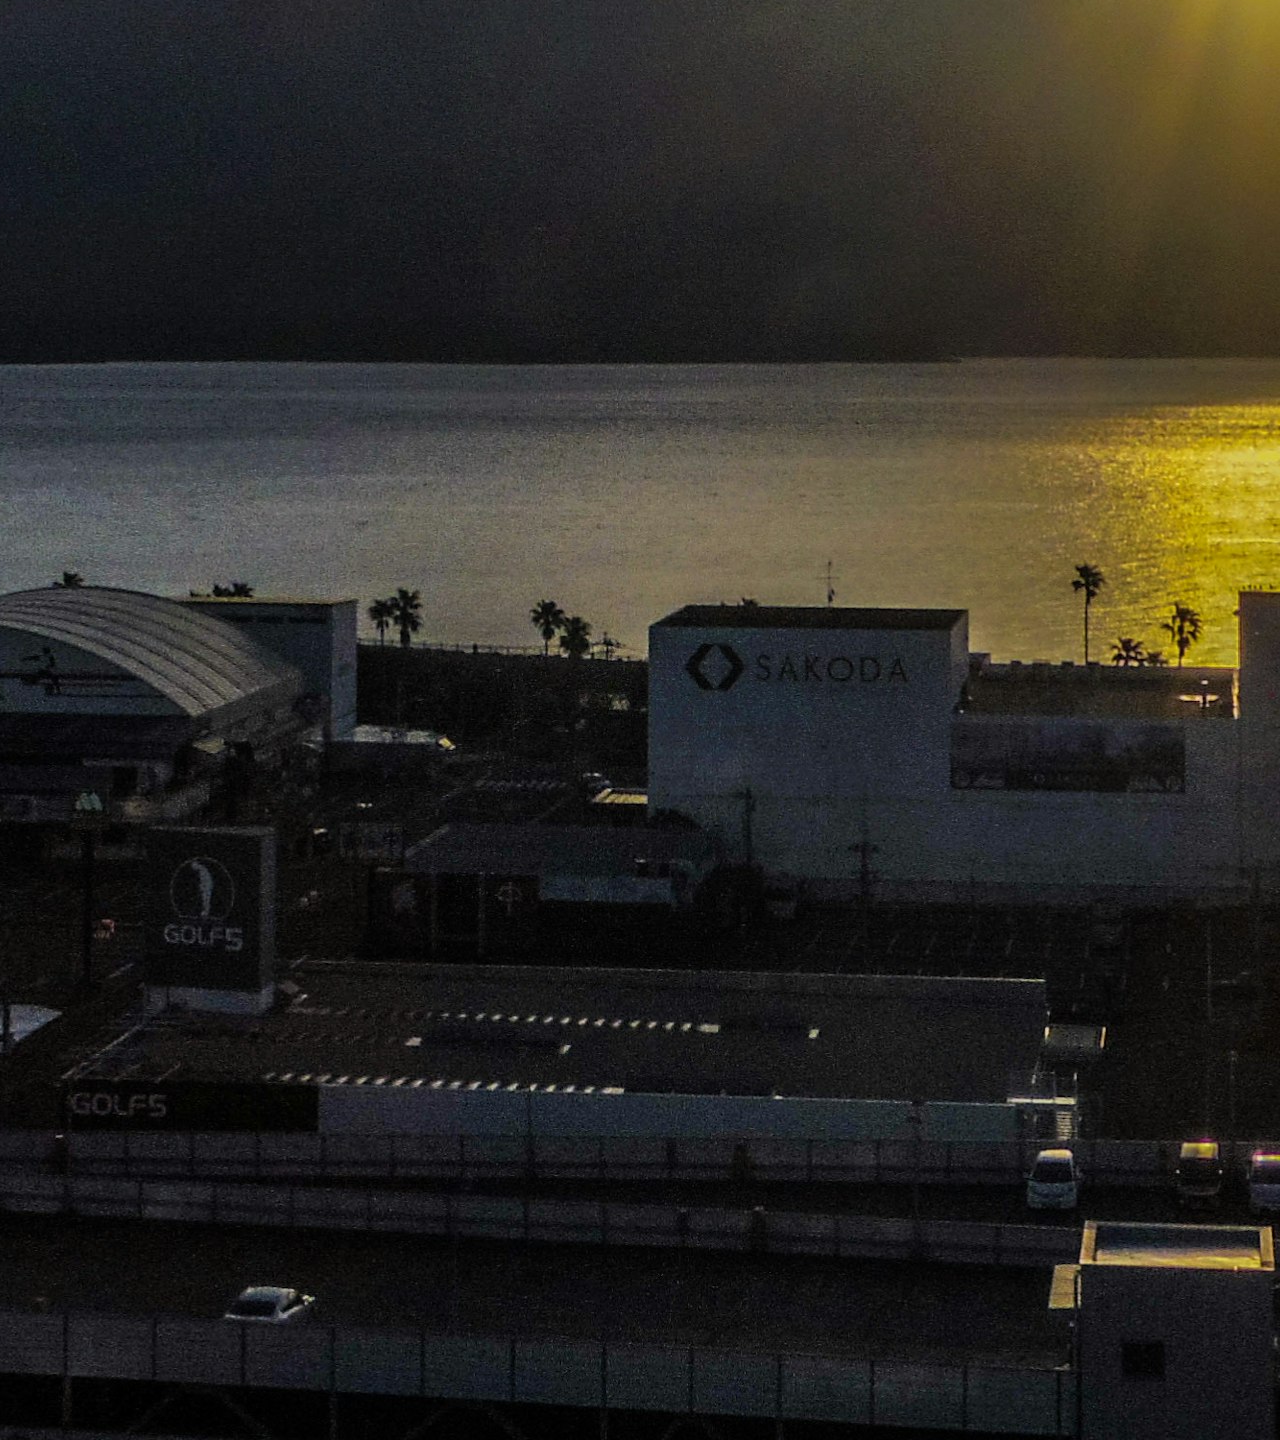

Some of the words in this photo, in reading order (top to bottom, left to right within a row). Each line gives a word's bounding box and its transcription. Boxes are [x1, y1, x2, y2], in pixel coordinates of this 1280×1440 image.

[754, 653, 910, 684] SAKODA
[163, 923, 244, 952] GOLF5
[70, 1091, 169, 1119] GOLF5
